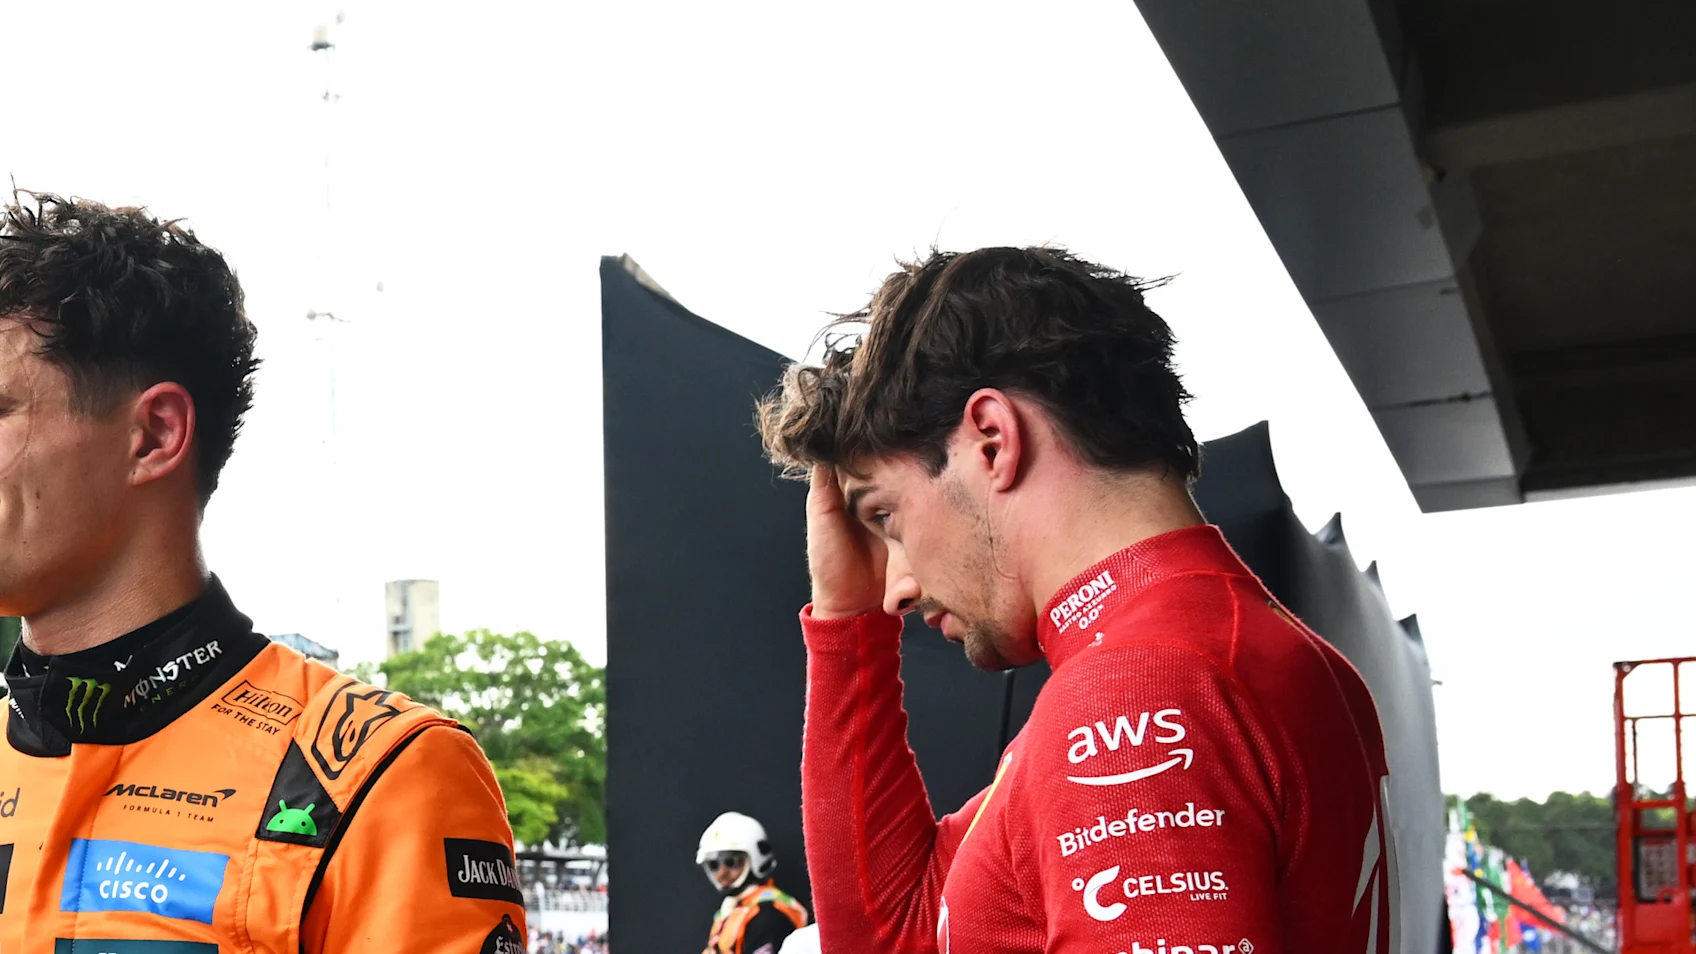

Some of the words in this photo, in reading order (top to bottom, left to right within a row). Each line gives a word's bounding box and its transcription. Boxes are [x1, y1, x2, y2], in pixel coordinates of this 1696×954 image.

[1050, 570, 1115, 628] PERONI
[211, 703, 234, 716] FOR
[235, 712, 255, 727] THE
[256, 721, 281, 736] STAY
[233, 689, 293, 719] Hilton
[1067, 708, 1186, 764] aws
[123, 804, 171, 816] FORMULA
[187, 813, 214, 822] TEAM
[1057, 802, 1225, 857] Bitdefender
[458, 854, 499, 886] JACK
[1190, 892, 1211, 901] LIVE
[1213, 892, 1227, 901] FIT
